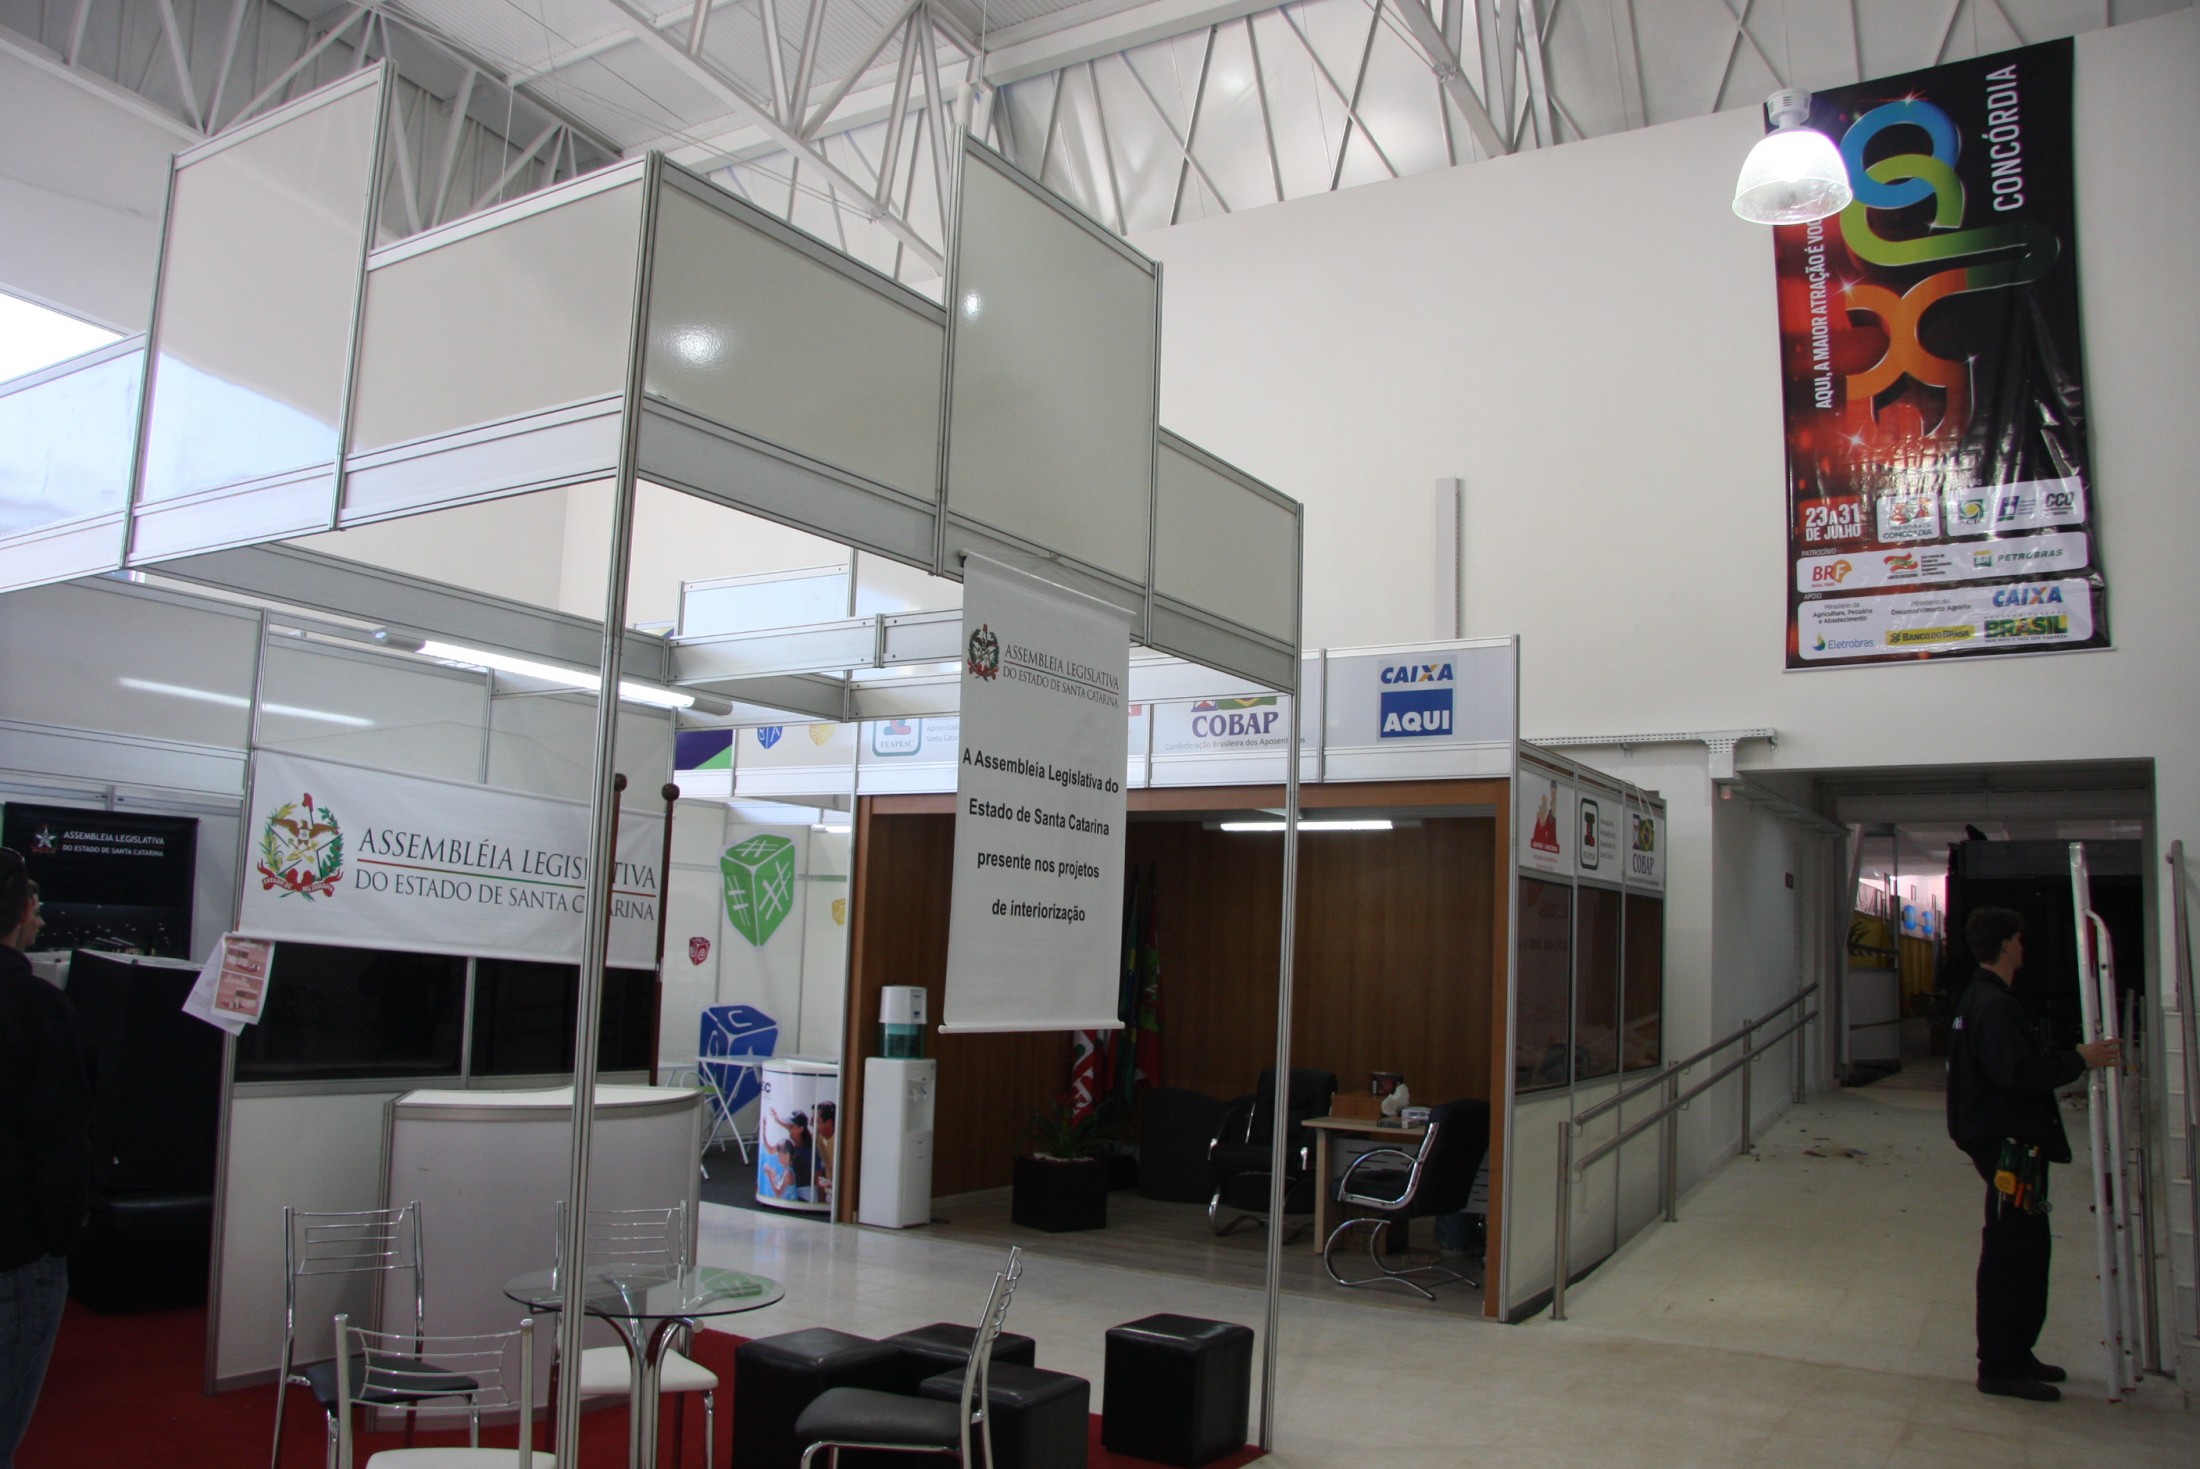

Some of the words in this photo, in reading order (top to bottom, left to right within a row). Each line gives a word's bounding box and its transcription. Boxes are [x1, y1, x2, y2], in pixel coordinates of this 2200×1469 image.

[1982, 64, 2024, 211] CONCÓRDIA
[1807, 219, 1824, 245] VOC
[1804, 244, 1824, 254] É
[1805, 255, 1830, 314] ATRAÇÃO
[1811, 318, 1829, 361] MAIOR
[1814, 361, 1830, 371] A
[1814, 371, 1833, 408] AQUI,
[1806, 527, 1820, 542] DE
[1824, 524, 1861, 540] JULHO
[1997, 549, 2063, 562] PETROBRAS
[1992, 586, 2063, 607] CAIXA
[1984, 614, 2068, 639] BRASIL
[1827, 638, 1874, 650] Eletrobras
[1004, 644, 1064, 674] ASSEMBLEIA
[1066, 661, 1119, 690] LEGISLATIVA
[1380, 663, 1454, 685] CAIXA
[1003, 665, 1017, 679] DO
[1018, 670, 1049, 688] ESTADO
[1050, 679, 1061, 691] DE
[1062, 682, 1086, 698] SANTA
[1086, 689, 1119, 709] CATARINA
[1191, 711, 1279, 738] COBAP
[1382, 710, 1450, 733] AQUI
[1212, 739, 1244, 748] Brasileira
[1245, 738, 1258, 746] dos
[962, 747, 972, 765] A
[974, 750, 1045, 779] Assembleia
[1048, 764, 1103, 791] Legislativa
[1105, 777, 1119, 793] do
[969, 797, 1013, 820] Estado
[1016, 806, 1031, 823] de
[1034, 808, 1066, 829] Santa
[1068, 814, 1110, 836] Catarina
[74, 845, 100, 853] ESTADO
[101, 846, 110, 854] DE
[111, 847, 132, 855] SANTA
[133, 848, 164, 857] CATARINA
[115, 834, 165, 845] LEGISLATIVA
[358, 827, 514, 872] ASSEMBLÉIA
[520, 848, 657, 889] LEGISLTIVA
[977, 851, 1031, 870] presente
[1034, 858, 1055, 873] nos
[1058, 860, 1100, 880] projetos
[354, 868, 389, 892] DO
[394, 873, 473, 903] ESTADO
[477, 883, 503, 905] DE
[508, 886, 568, 914] SANTA
[572, 894, 655, 921] CRINA
[991, 898, 1007, 916] de
[1010, 900, 1086, 925] interiorização
